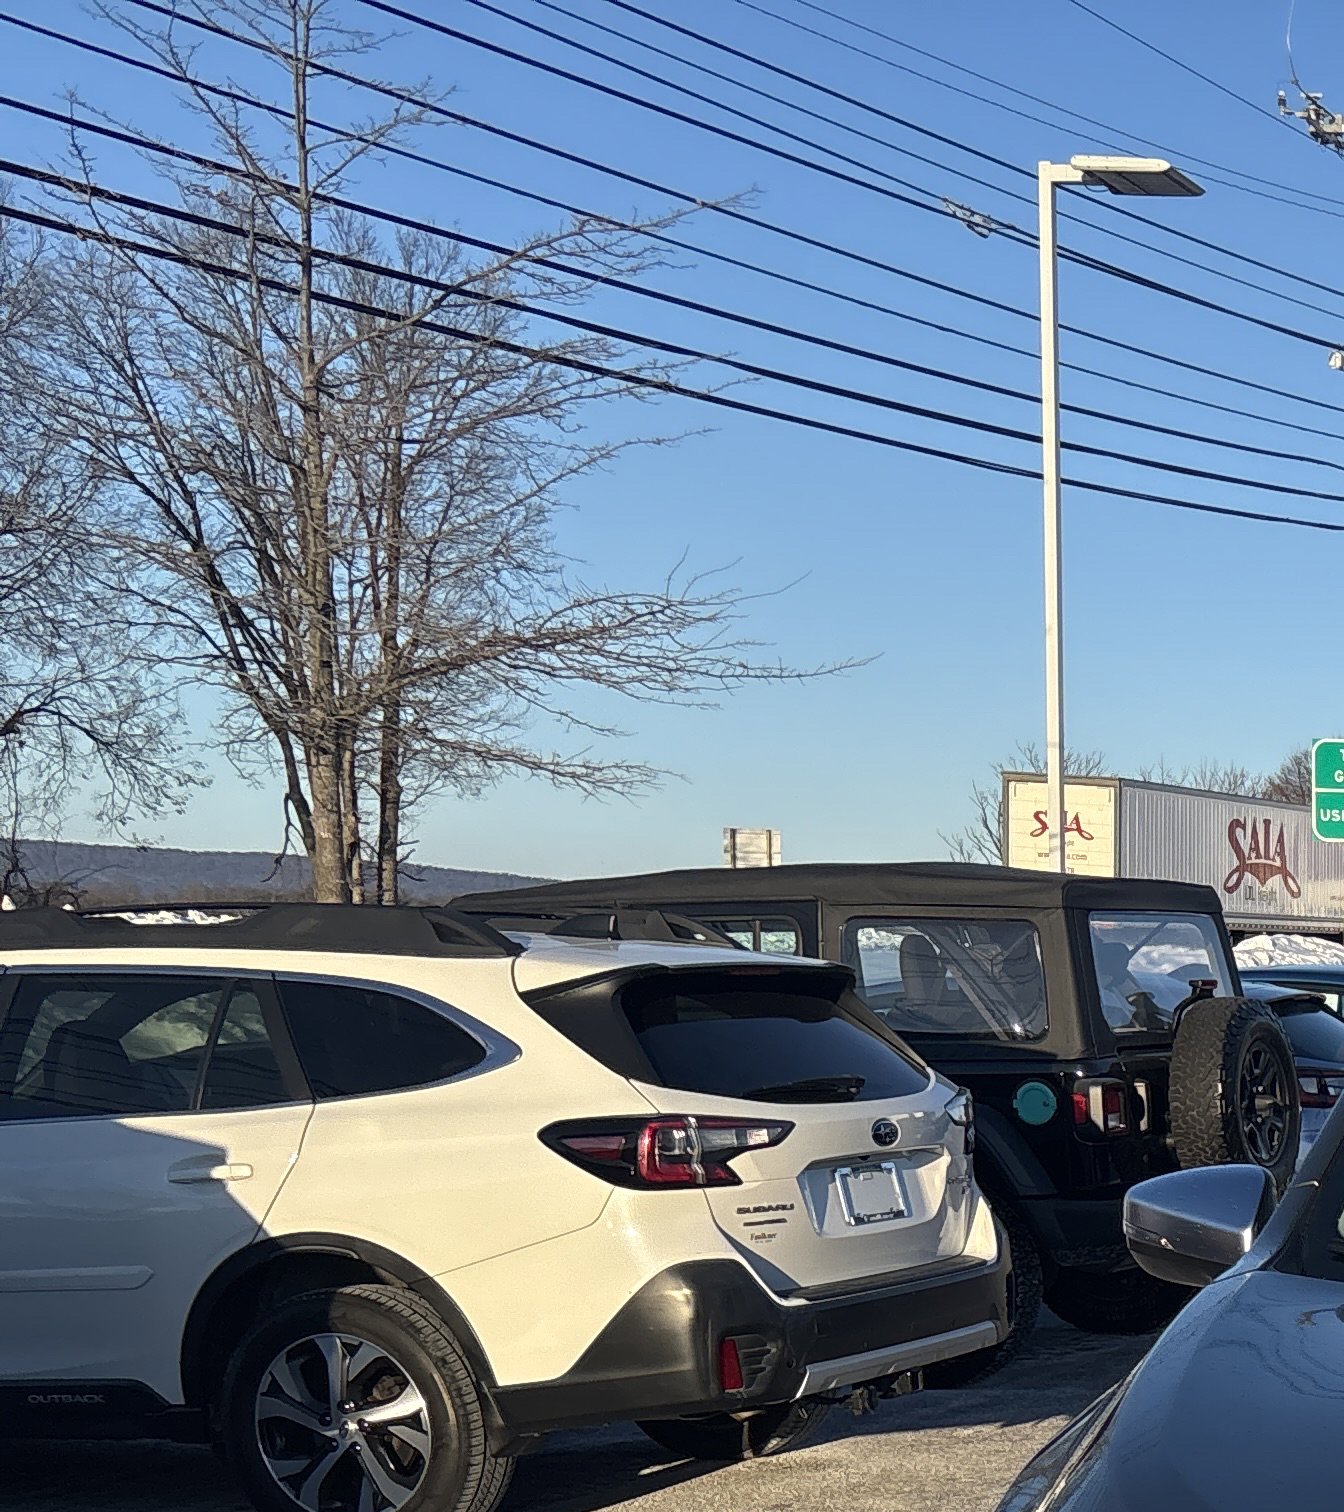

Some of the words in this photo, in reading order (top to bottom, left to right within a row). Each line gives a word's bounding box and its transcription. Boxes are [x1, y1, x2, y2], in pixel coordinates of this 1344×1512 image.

[1223, 816, 1301, 899] SAIA
[736, 1203, 795, 1214] SUBARU
[27, 1394, 105, 1404] OUTBACK
